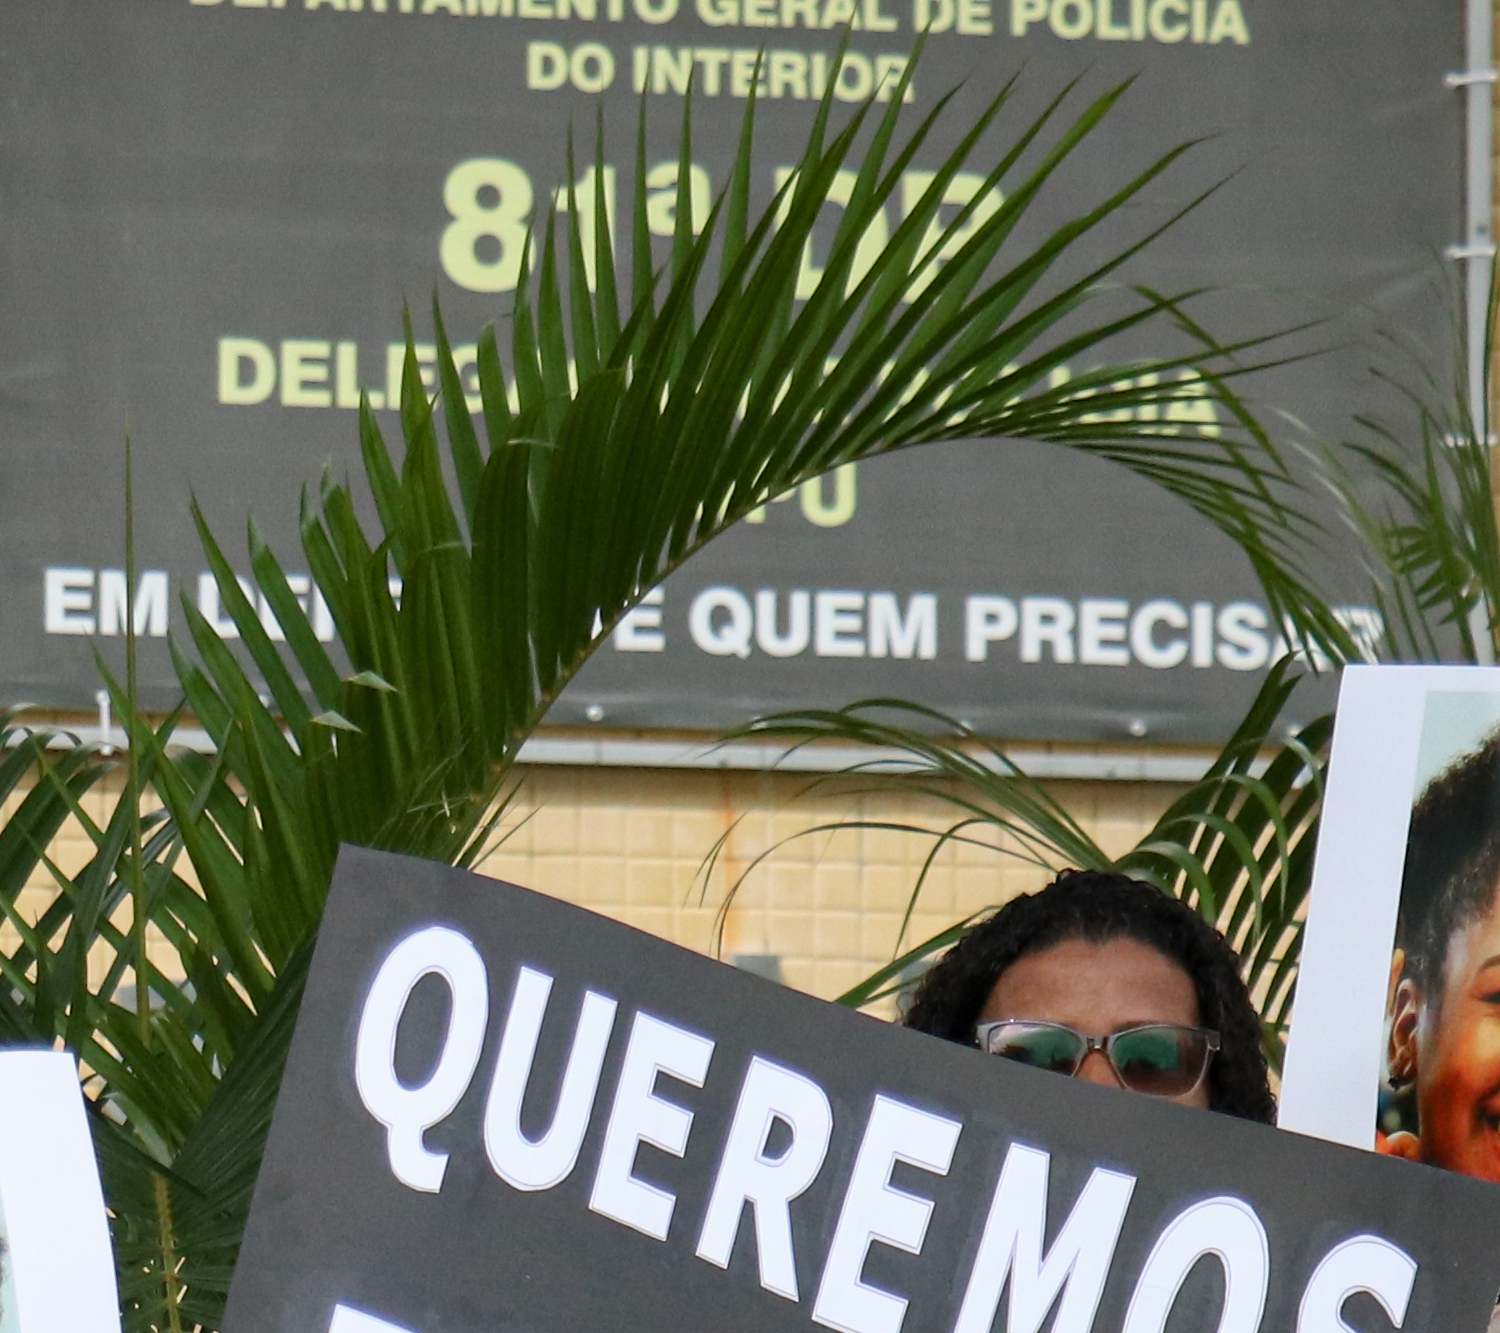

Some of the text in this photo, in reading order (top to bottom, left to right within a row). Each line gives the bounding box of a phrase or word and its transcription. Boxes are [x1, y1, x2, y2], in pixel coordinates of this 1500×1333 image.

[913, 0, 993, 36] DE
[526, 40, 916, 103] DO INTERIOR
[44, 567, 168, 637] EM
[689, 584, 939, 661] QUEM
